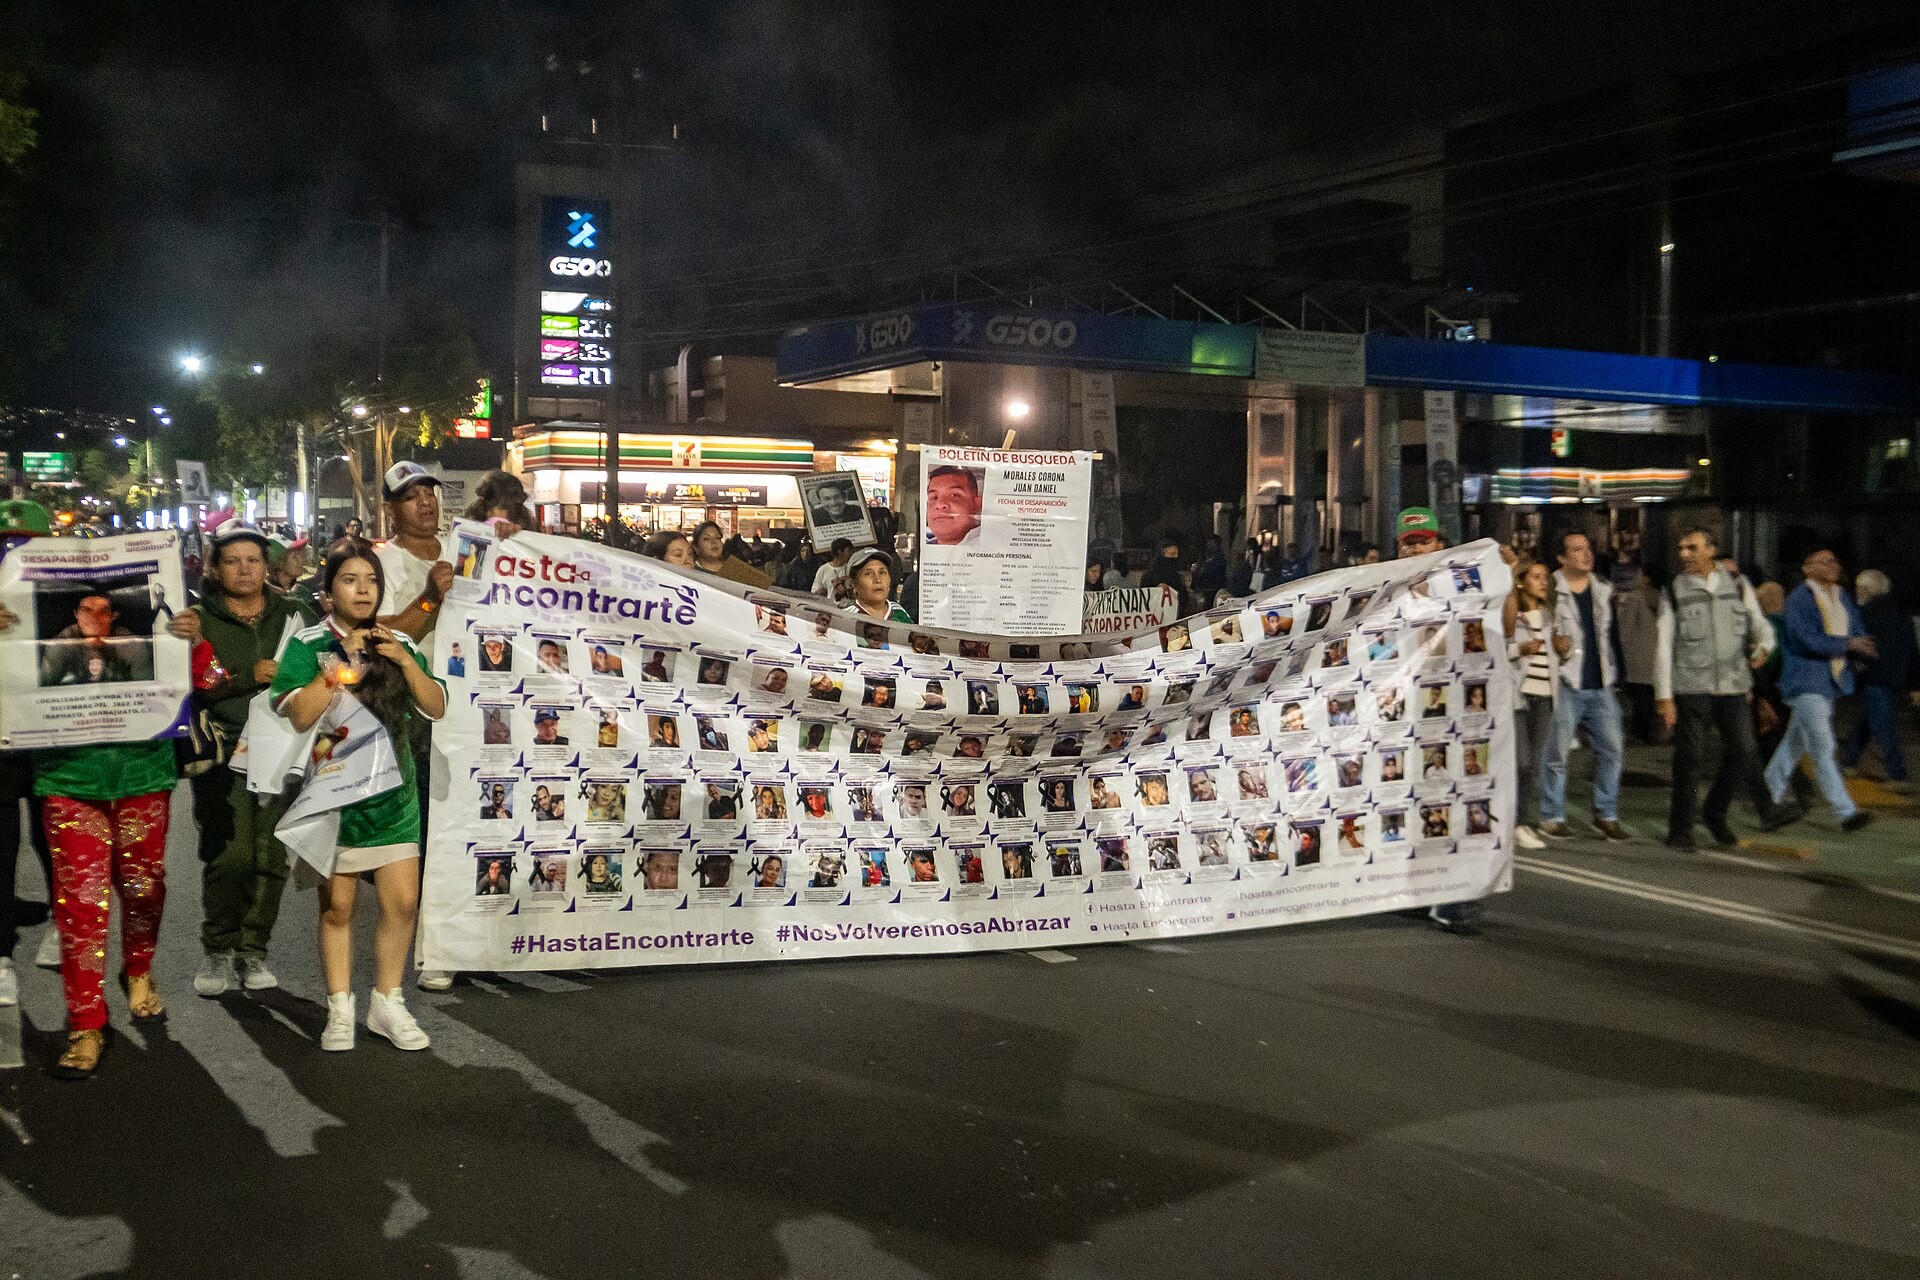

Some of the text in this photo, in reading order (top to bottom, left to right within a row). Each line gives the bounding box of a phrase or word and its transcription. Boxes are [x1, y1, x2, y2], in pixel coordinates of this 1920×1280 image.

[550, 256, 612, 278] G500
[986, 316, 1078, 348] G500
[994, 452, 1008, 464] DE
[1011, 454, 1076, 466] BUSQUEDA
[802, 474, 853, 484] DESAPARECIDO
[1002, 470, 1066, 482] MORALES CORONA
[1013, 482, 1058, 494] JUAN DANIEL
[998, 498, 1068, 508] FECHA DE DESAPARICIÓN:
[966, 552, 1004, 560] INFORMACIÓN
[494, 554, 578, 584] asta
[490, 582, 698, 626] ncontrarte
[1240, 880, 1340, 900] hasta.encontrarte
[1100, 902, 1136, 913] Hasta
[776, 915, 1071, 942] #NosVolveremosaAbrazar
[1103, 922, 1139, 932] Hasta
[510, 928, 754, 954] #HastaEncontrarte
